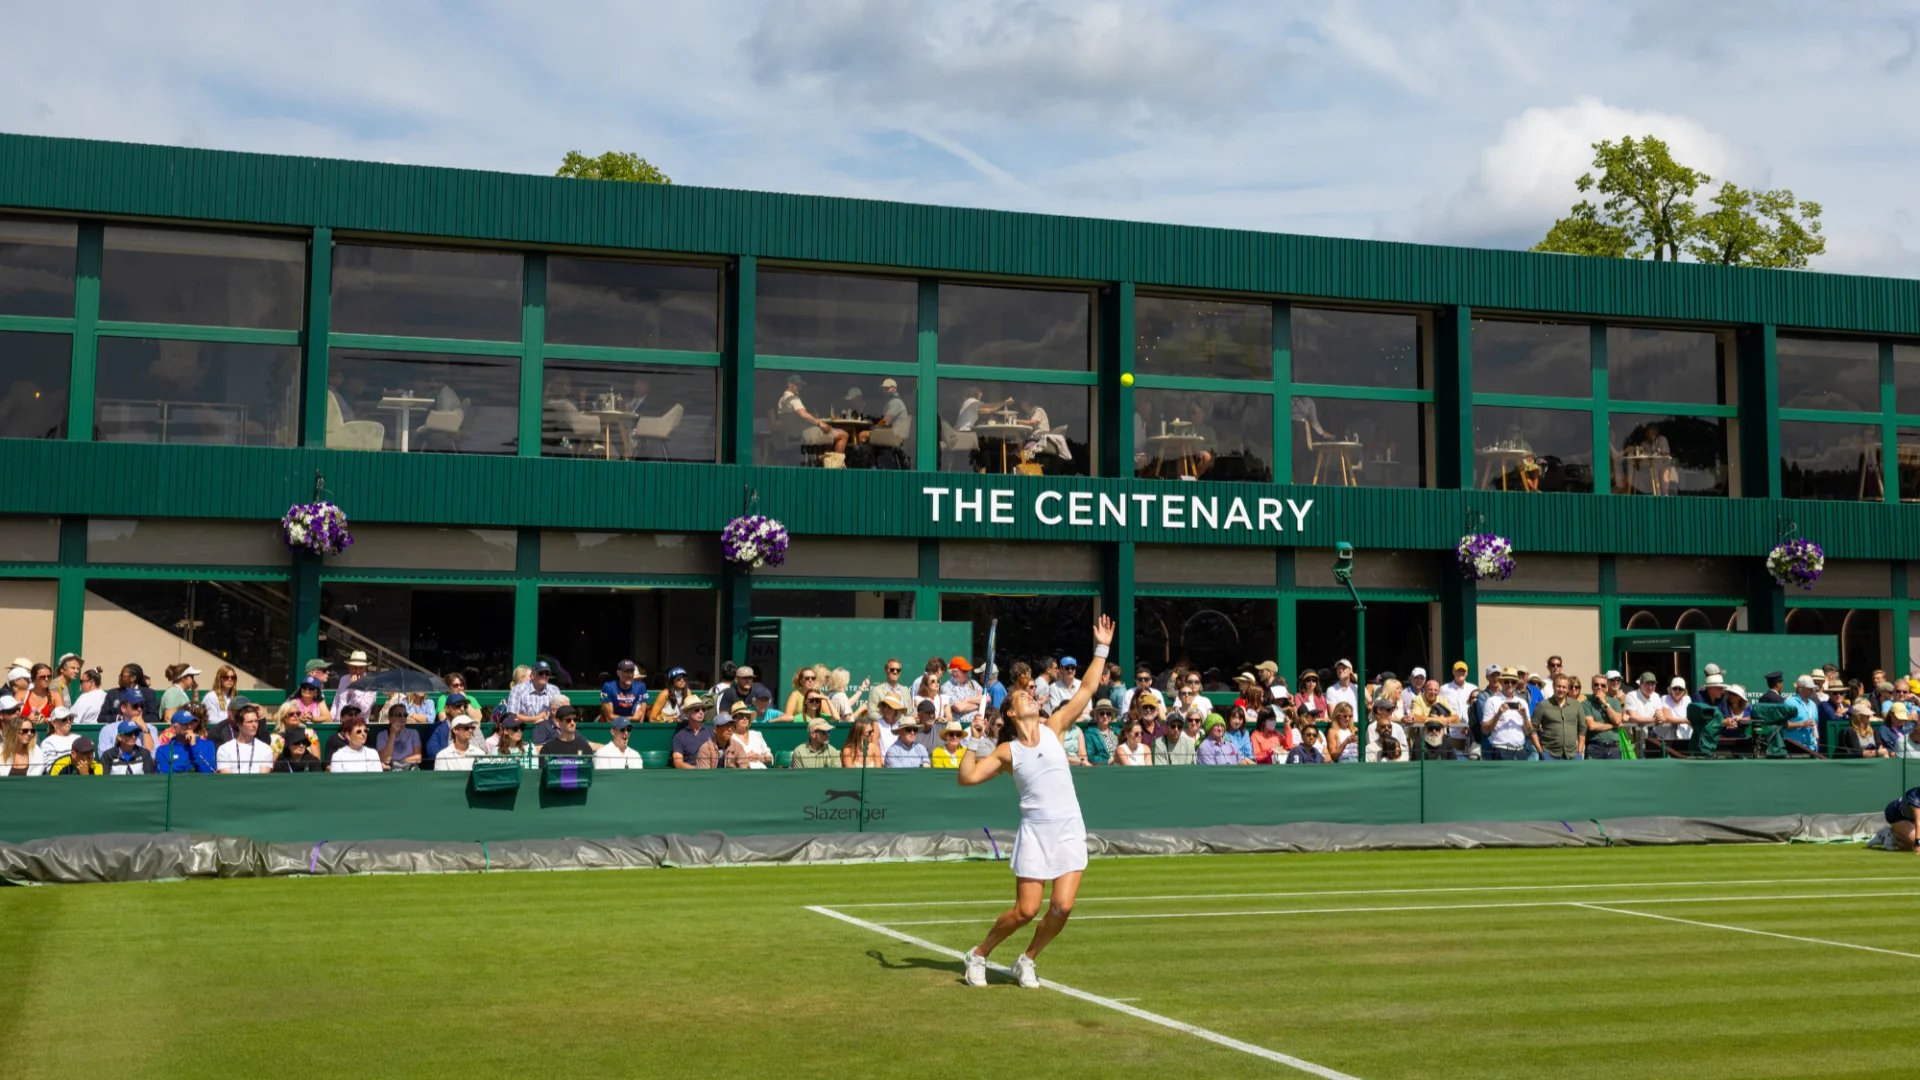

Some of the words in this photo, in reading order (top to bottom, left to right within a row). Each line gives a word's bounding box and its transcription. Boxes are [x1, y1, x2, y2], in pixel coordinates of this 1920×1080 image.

[923, 487, 1015, 524] THE
[1035, 490, 1314, 532] CENTENARY
[1293, 755, 1300, 763] 3
[803, 805, 888, 824] Slazenger
